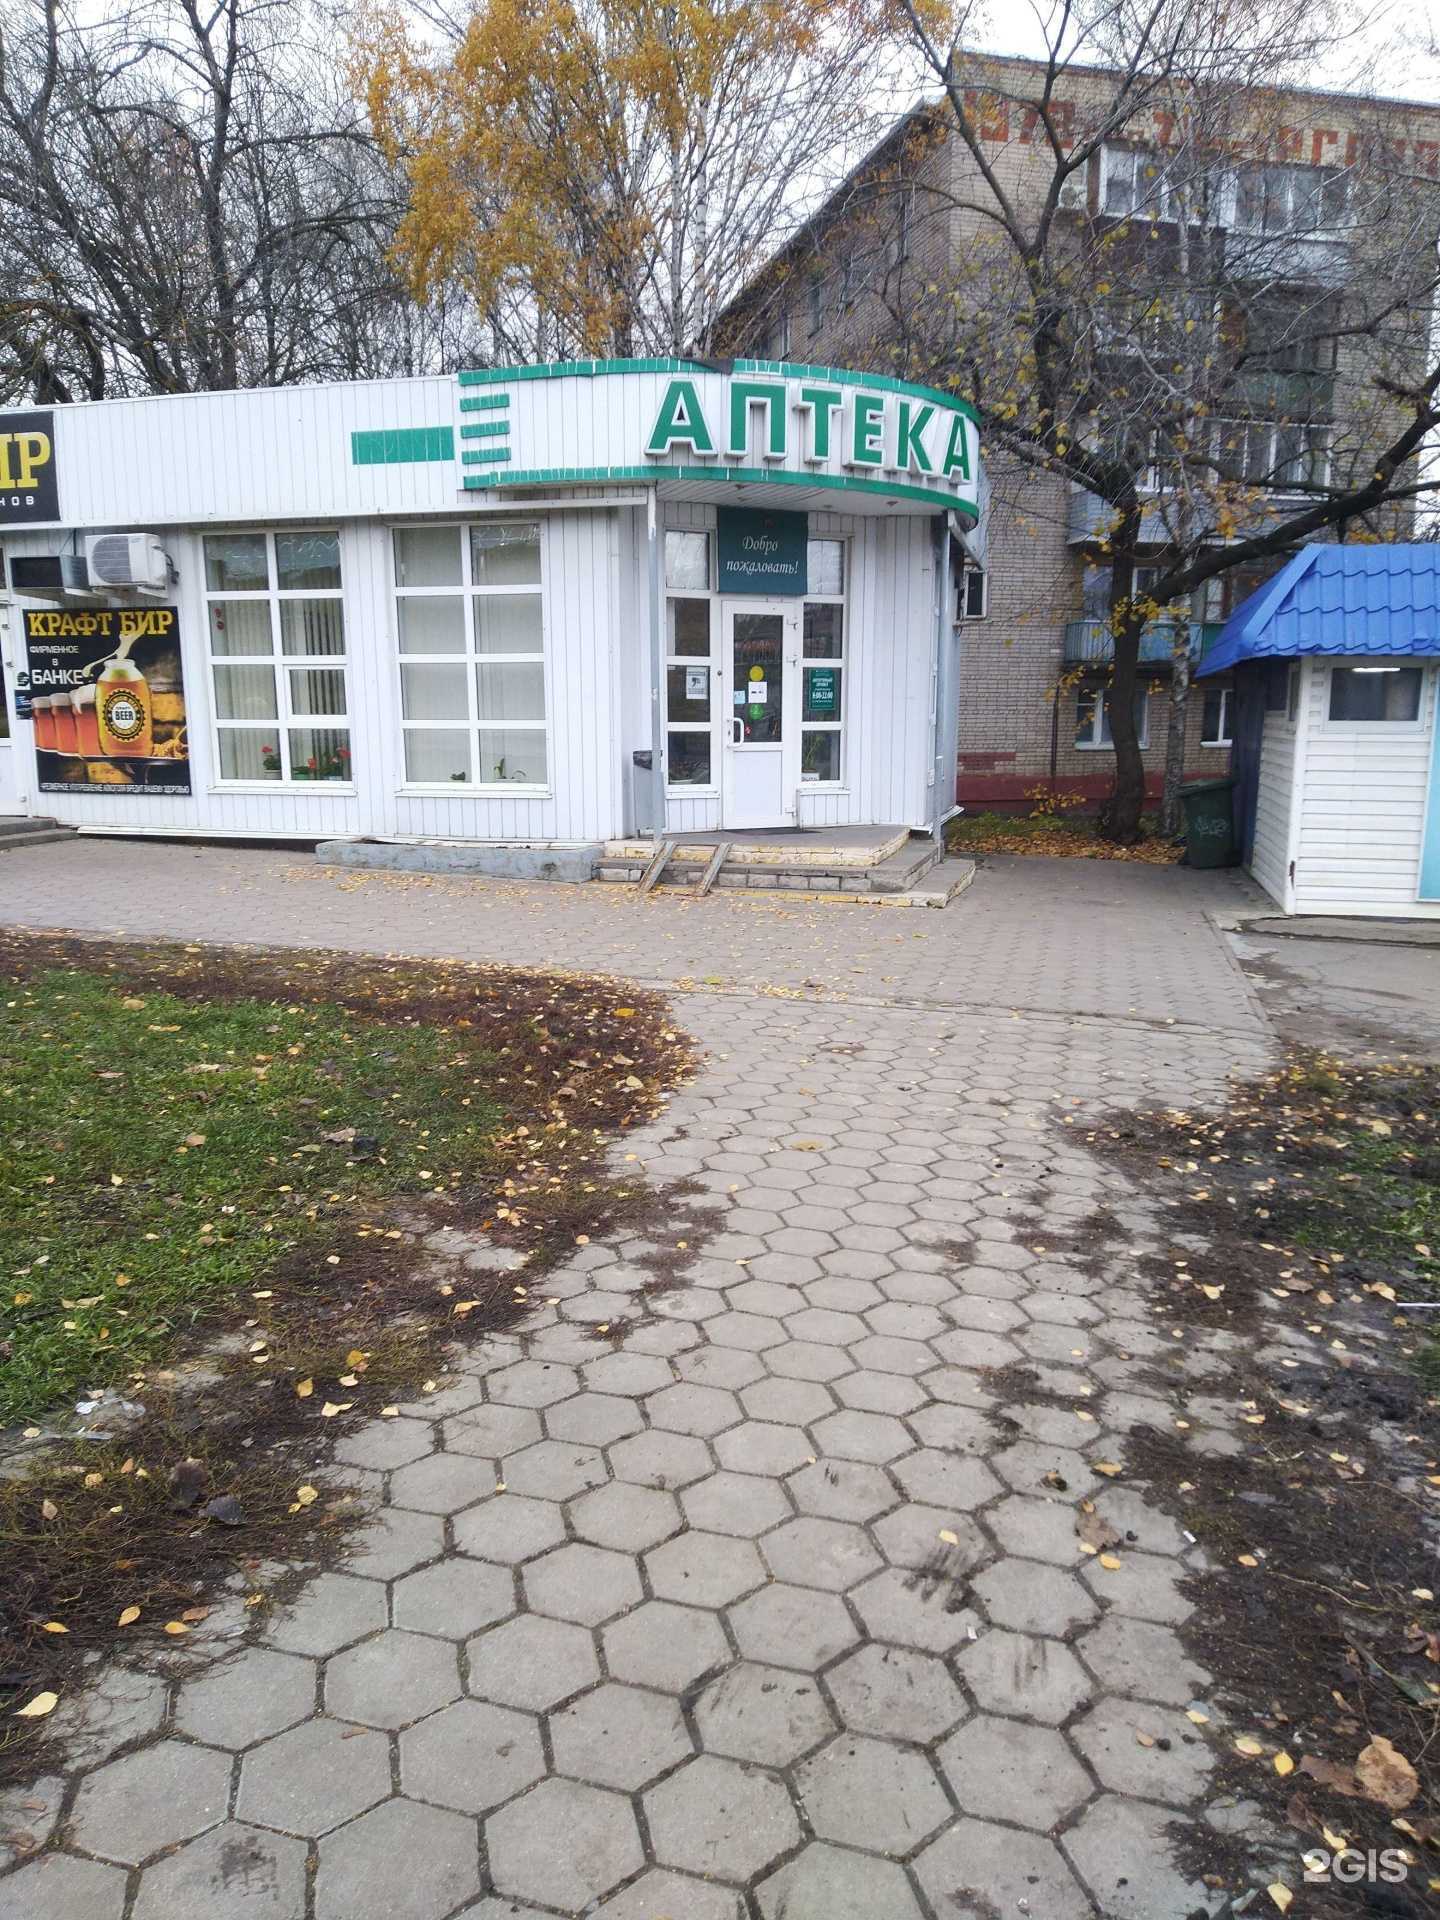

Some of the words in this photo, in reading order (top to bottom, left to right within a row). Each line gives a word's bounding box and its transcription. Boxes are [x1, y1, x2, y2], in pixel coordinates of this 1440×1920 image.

[644, 377, 971, 485] АПТЕКА
[742, 535, 779, 556] Добро
[726, 560, 799, 576] пожаловать!
[27, 612, 113, 637] КРАФТ
[118, 610, 174, 636] БИР
[29, 645, 80, 654] ФИРМЕННОЕ
[31, 669, 84, 685] БАНКЕ
[115, 710, 134, 720] BEER
